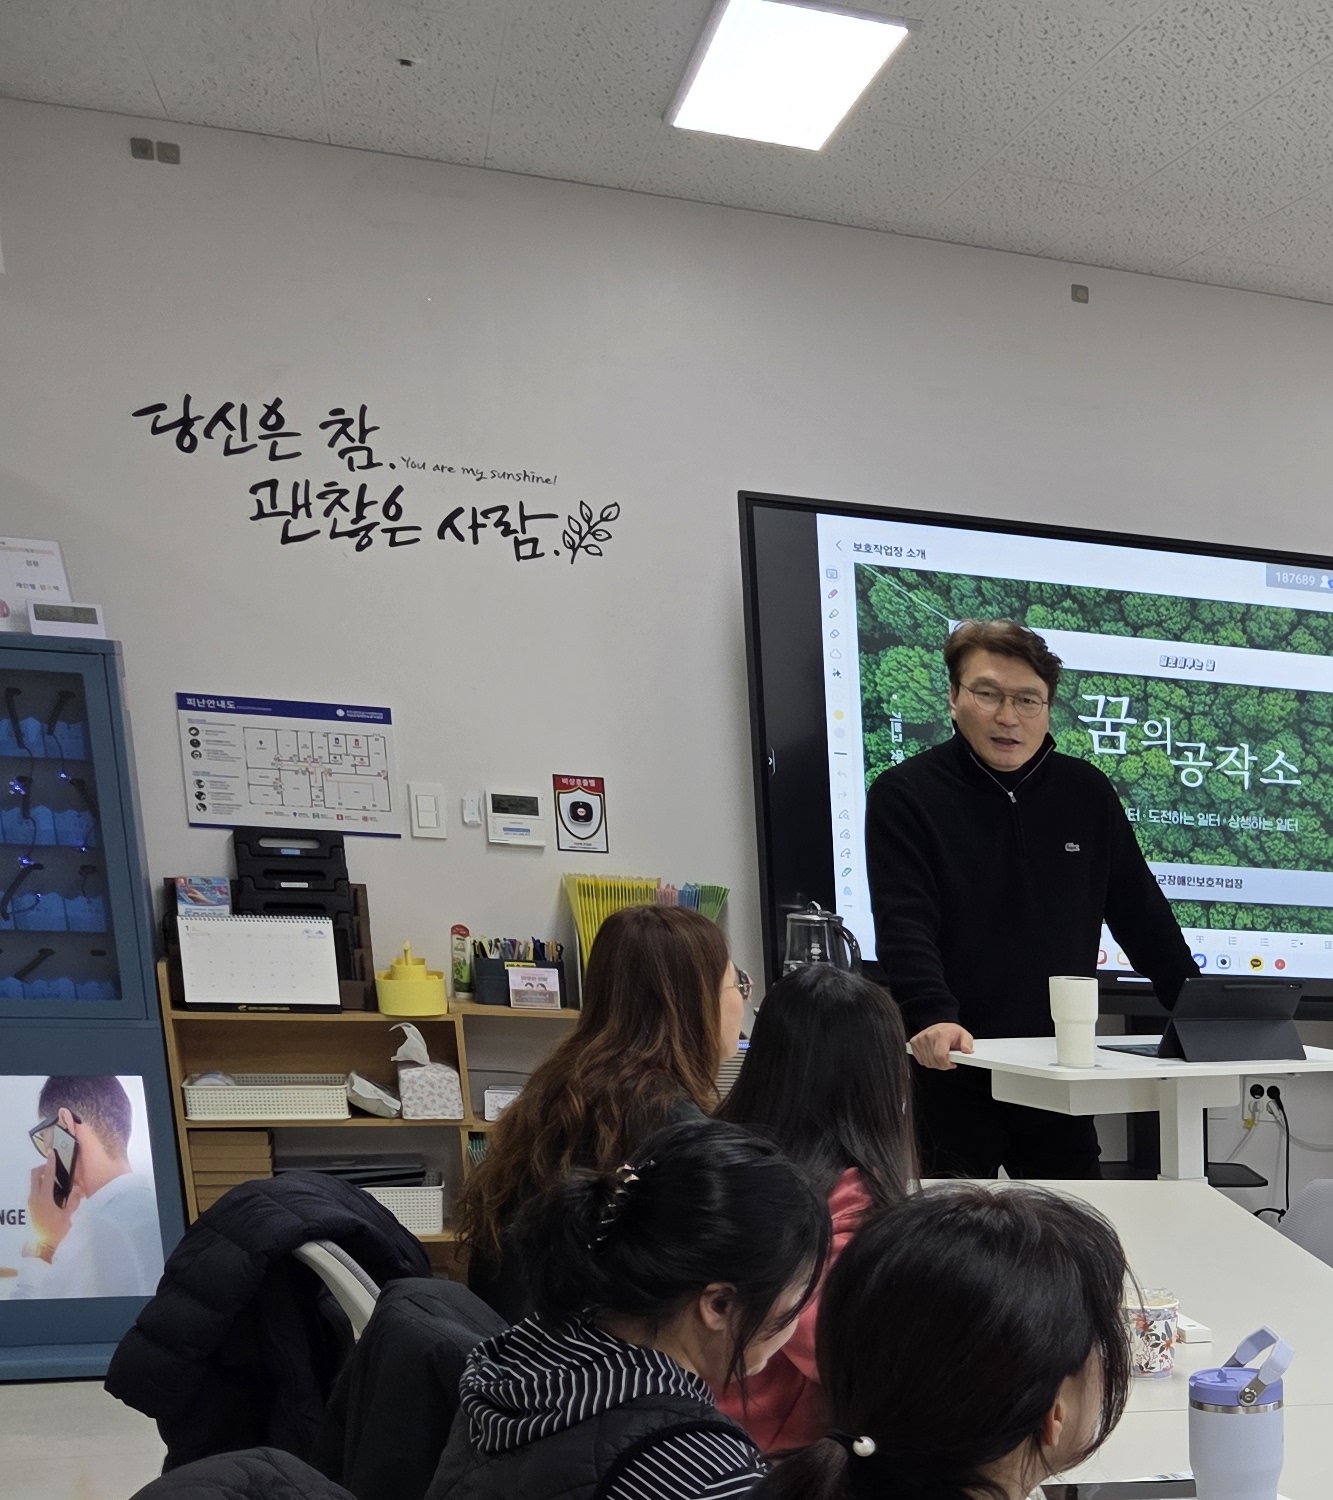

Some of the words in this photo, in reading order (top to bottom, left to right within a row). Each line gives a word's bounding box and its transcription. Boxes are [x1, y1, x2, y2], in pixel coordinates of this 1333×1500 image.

[132, 394, 302, 461] 당신은
[401, 456, 425, 470] You
[432, 462, 455, 474] are
[461, 467, 487, 481] my
[249, 478, 422, 552] 괜찮은
[853, 542, 903, 557] 보호작업장
[906, 548, 927, 560] 소개
[1276, 572, 1316, 586] 187689
[187, 698, 236, 709] 피난안내도
[1149, 809, 1195, 826] 도전하는
[1197, 813, 1220, 826] 일터
[1228, 815, 1274, 830] 상생하는
[1276, 817, 1298, 832] 일터
